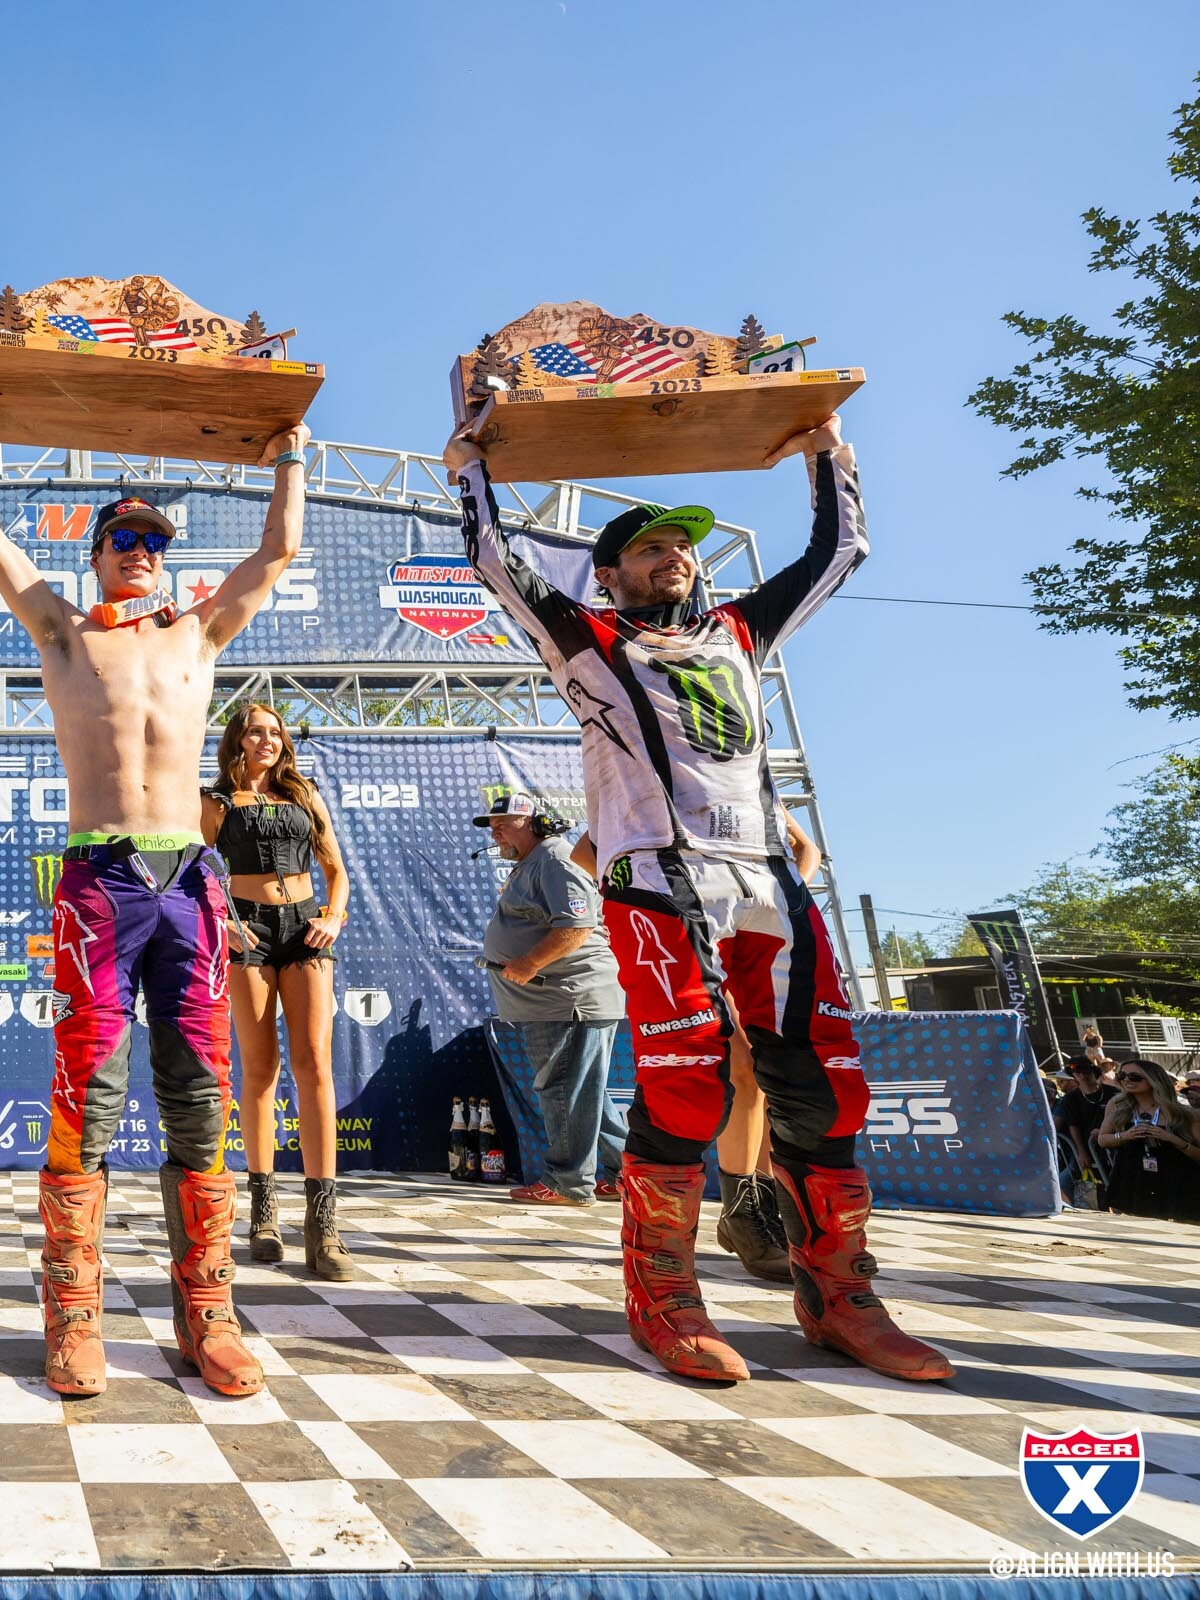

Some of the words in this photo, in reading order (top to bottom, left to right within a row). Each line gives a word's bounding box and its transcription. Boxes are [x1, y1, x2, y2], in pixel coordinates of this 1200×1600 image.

[175, 317, 227, 337] 450
[638, 326, 695, 348] 450
[128, 345, 178, 363] 2023
[650, 378, 702, 395] 2023
[398, 590, 486, 606] WASHOUGAL
[409, 609, 479, 619] NATIONAL
[341, 784, 420, 808] 2023
[639, 1008, 715, 1036] Kawasaki
[129, 1099, 140, 1112] 9
[130, 1119, 147, 1132] 16
[131, 1139, 150, 1152] 23
